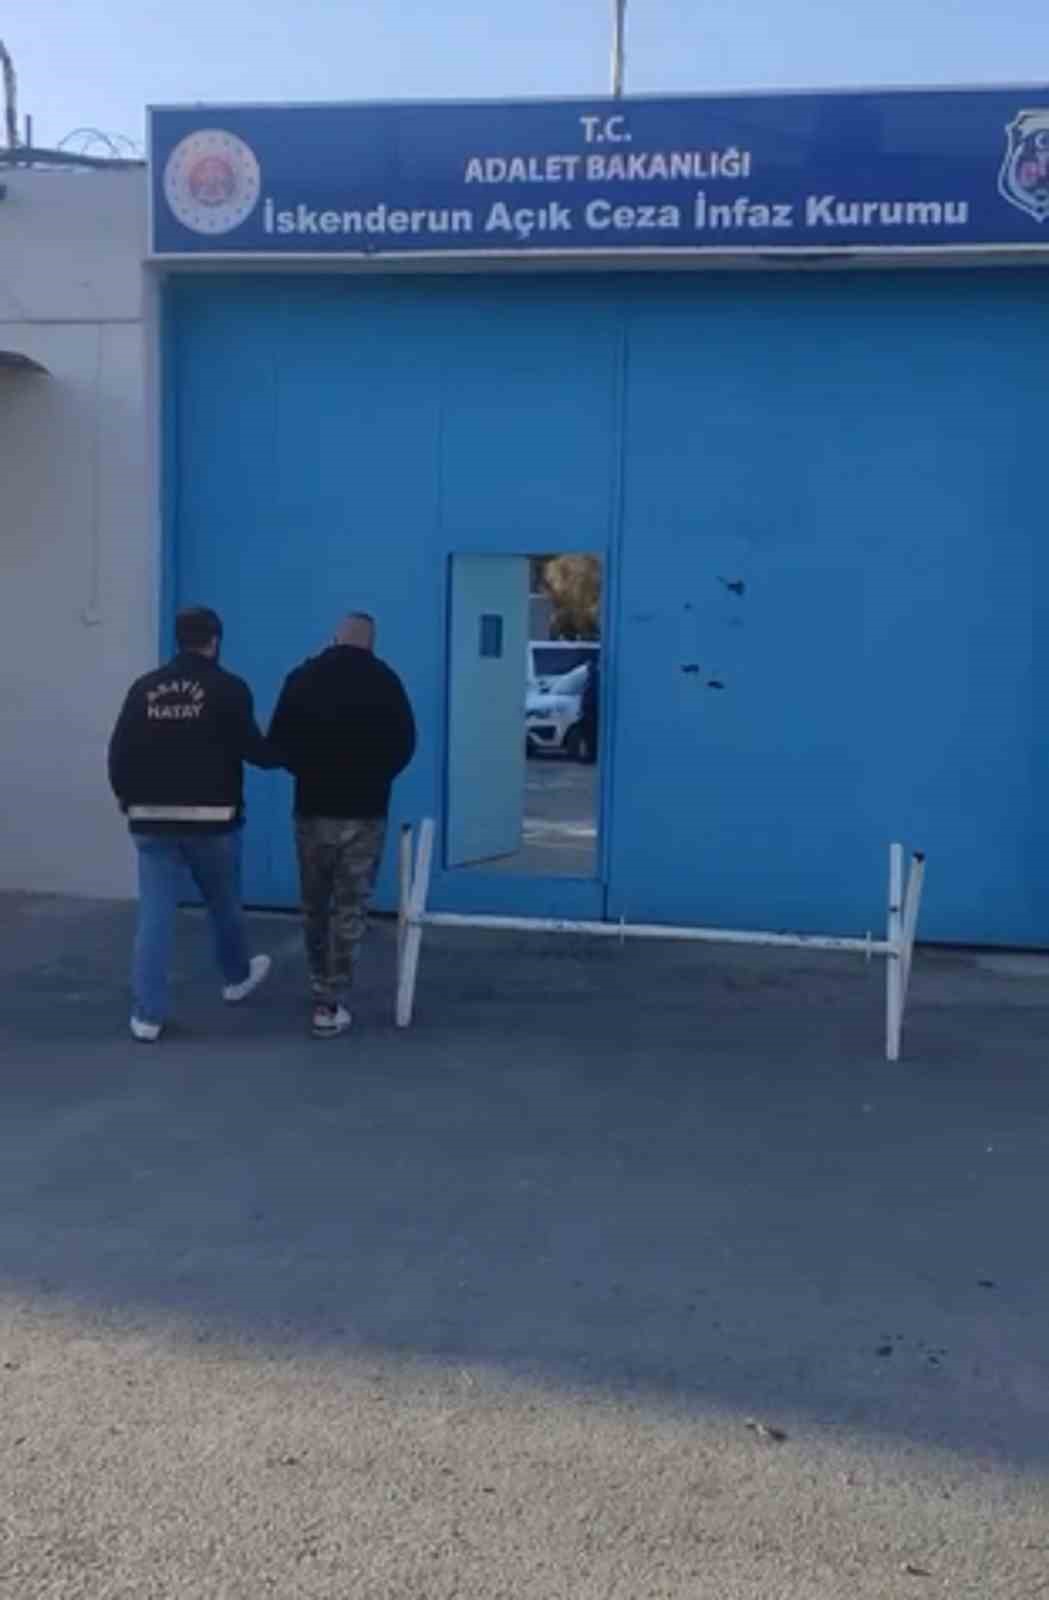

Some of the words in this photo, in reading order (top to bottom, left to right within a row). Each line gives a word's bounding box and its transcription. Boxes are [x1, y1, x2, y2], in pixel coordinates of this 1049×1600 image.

[580, 115, 632, 143] T.C.
[464, 155, 579, 184] ADALET
[587, 148, 751, 181] BAKANLIĞI
[263, 199, 473, 234] İskenderun
[484, 201, 572, 239] Açık
[585, 200, 680, 230] Ceza
[695, 192, 793, 228] İnfaz
[806, 196, 969, 226] Kurumu
